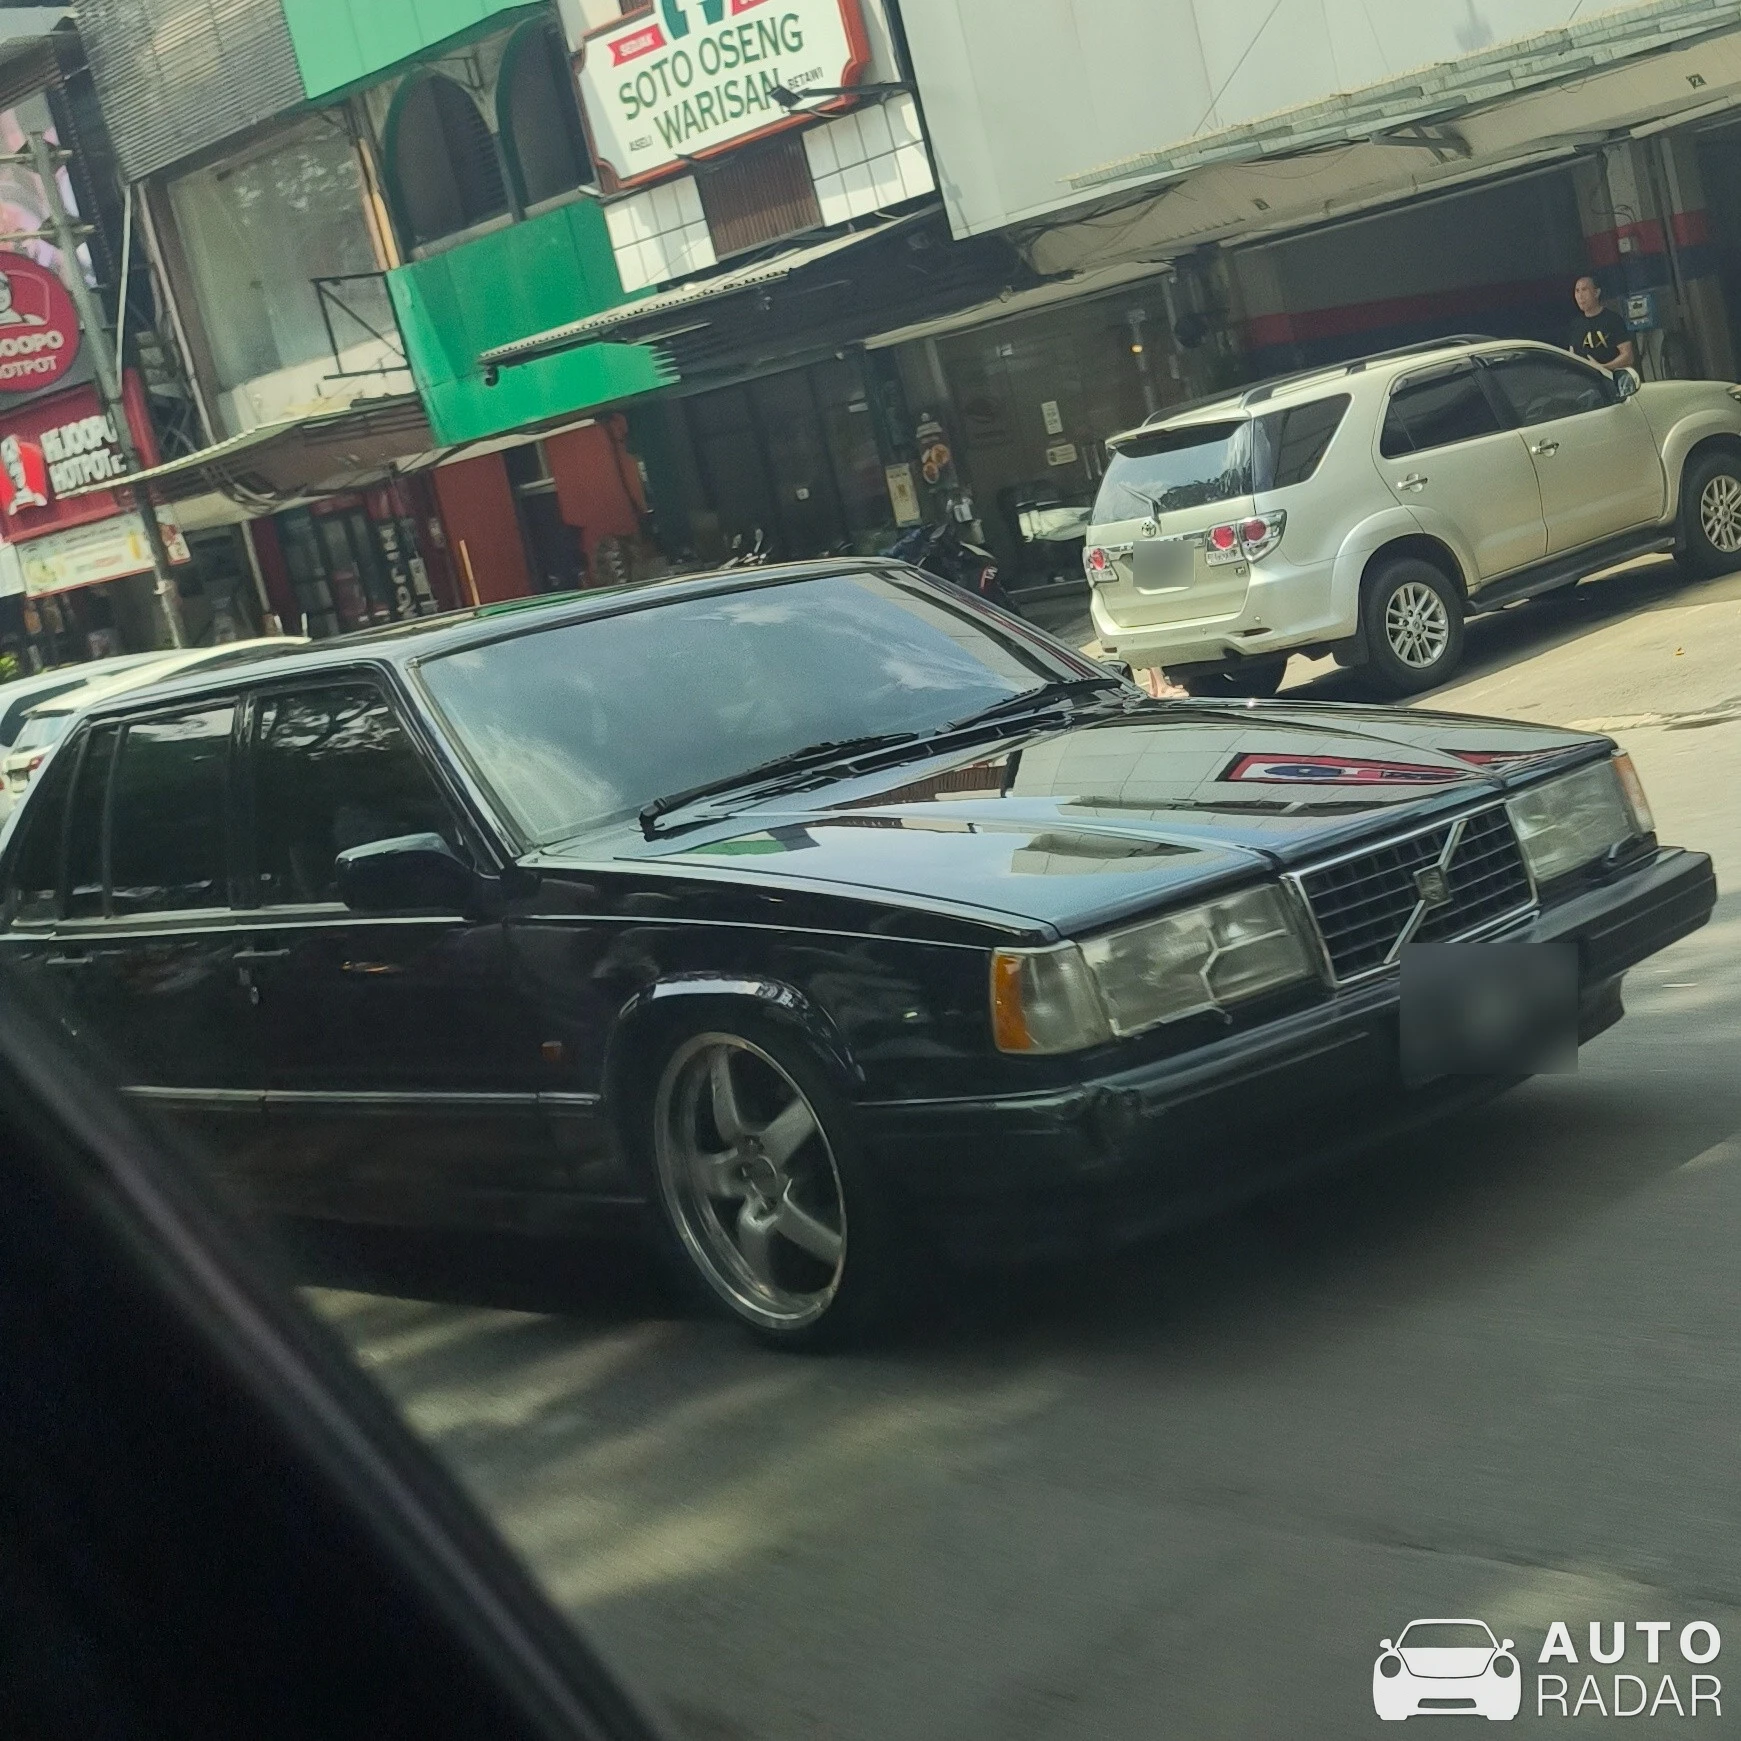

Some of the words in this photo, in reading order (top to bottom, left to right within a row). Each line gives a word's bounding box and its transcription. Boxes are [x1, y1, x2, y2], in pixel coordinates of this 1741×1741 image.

[619, 50, 693, 120] SOTO
[699, 13, 804, 76] OSENG
[653, 67, 783, 149] WARISAN
[0, 330, 64, 358] OOPO
[49, 448, 112, 493] HOTPOT
